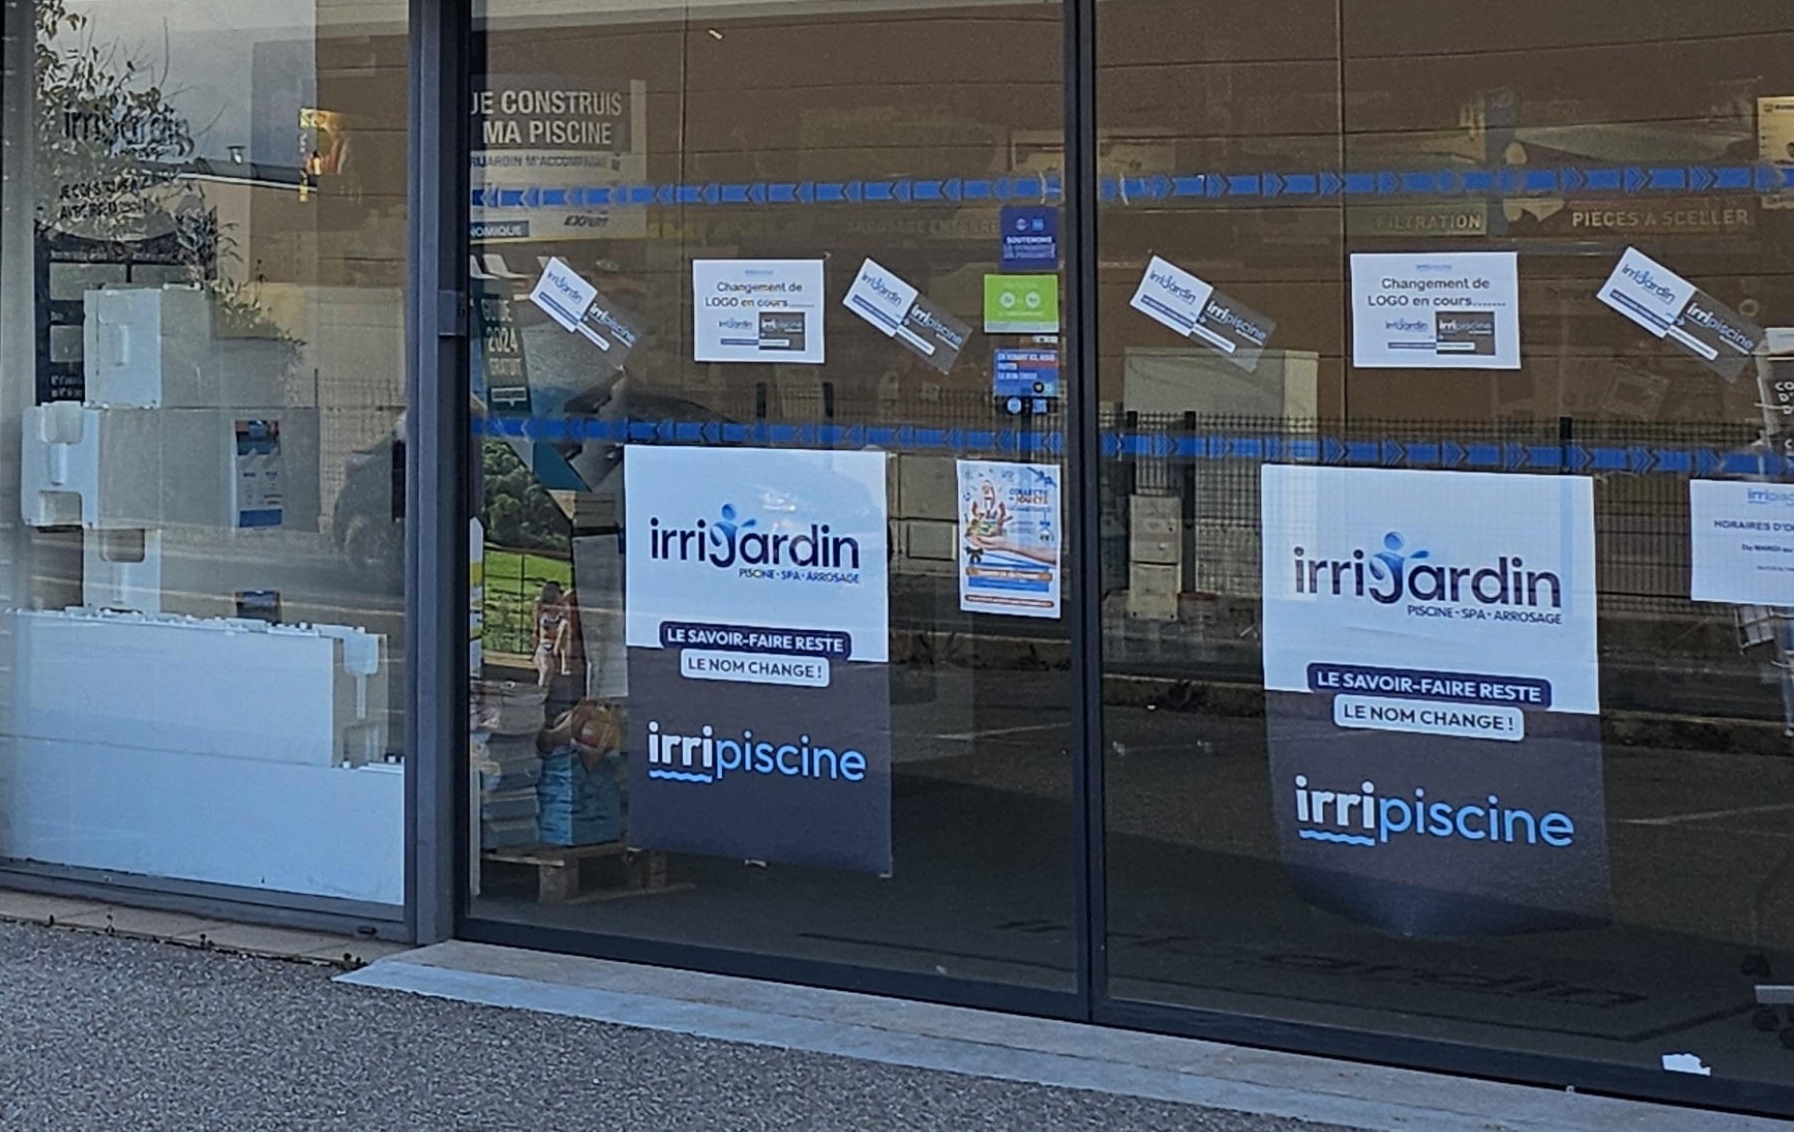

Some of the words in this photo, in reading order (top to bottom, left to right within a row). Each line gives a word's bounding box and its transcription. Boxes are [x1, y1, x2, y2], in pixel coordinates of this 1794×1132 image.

[501, 90, 623, 116] CONSTRUIS
[483, 121, 522, 144] MA
[529, 121, 612, 145] PISCINE
[716, 281, 787, 294] Changement
[788, 282, 803, 293] de
[1381, 278, 1471, 292] Changement
[1472, 278, 1491, 290] de
[705, 297, 739, 307] LOGO
[1367, 295, 1409, 307] LOGO
[1412, 298, 1430, 307] en
[650, 502, 860, 569] irrijardin
[1714, 519, 1770, 531] HORAIRES
[739, 568, 775, 580] PISCINE
[781, 570, 800, 581] SPA
[806, 572, 860, 584] ARROSAGE
[1294, 531, 1562, 609] irrijardin
[1407, 604, 1453, 618] PISCINE
[1461, 608, 1487, 620] SPA
[1494, 610, 1563, 625] ARROSAGE
[667, 627, 686, 643] LE
[687, 629, 793, 650] SAVOIR-FAIRE
[795, 636, 844, 653] RESTE
[688, 656, 706, 671] LE
[709, 658, 745, 673] NOM
[748, 661, 815, 679] CHANGE
[1317, 671, 1340, 687] LE
[1342, 673, 1477, 697] SAVOIR-FAIRE
[1479, 683, 1542, 703] RESTE
[1344, 703, 1366, 719] LE
[1370, 705, 1415, 723] NOM
[1420, 709, 1504, 730] CHANGE
[647, 720, 866, 782] irripiscine
[1294, 774, 1575, 847] irripiscine
